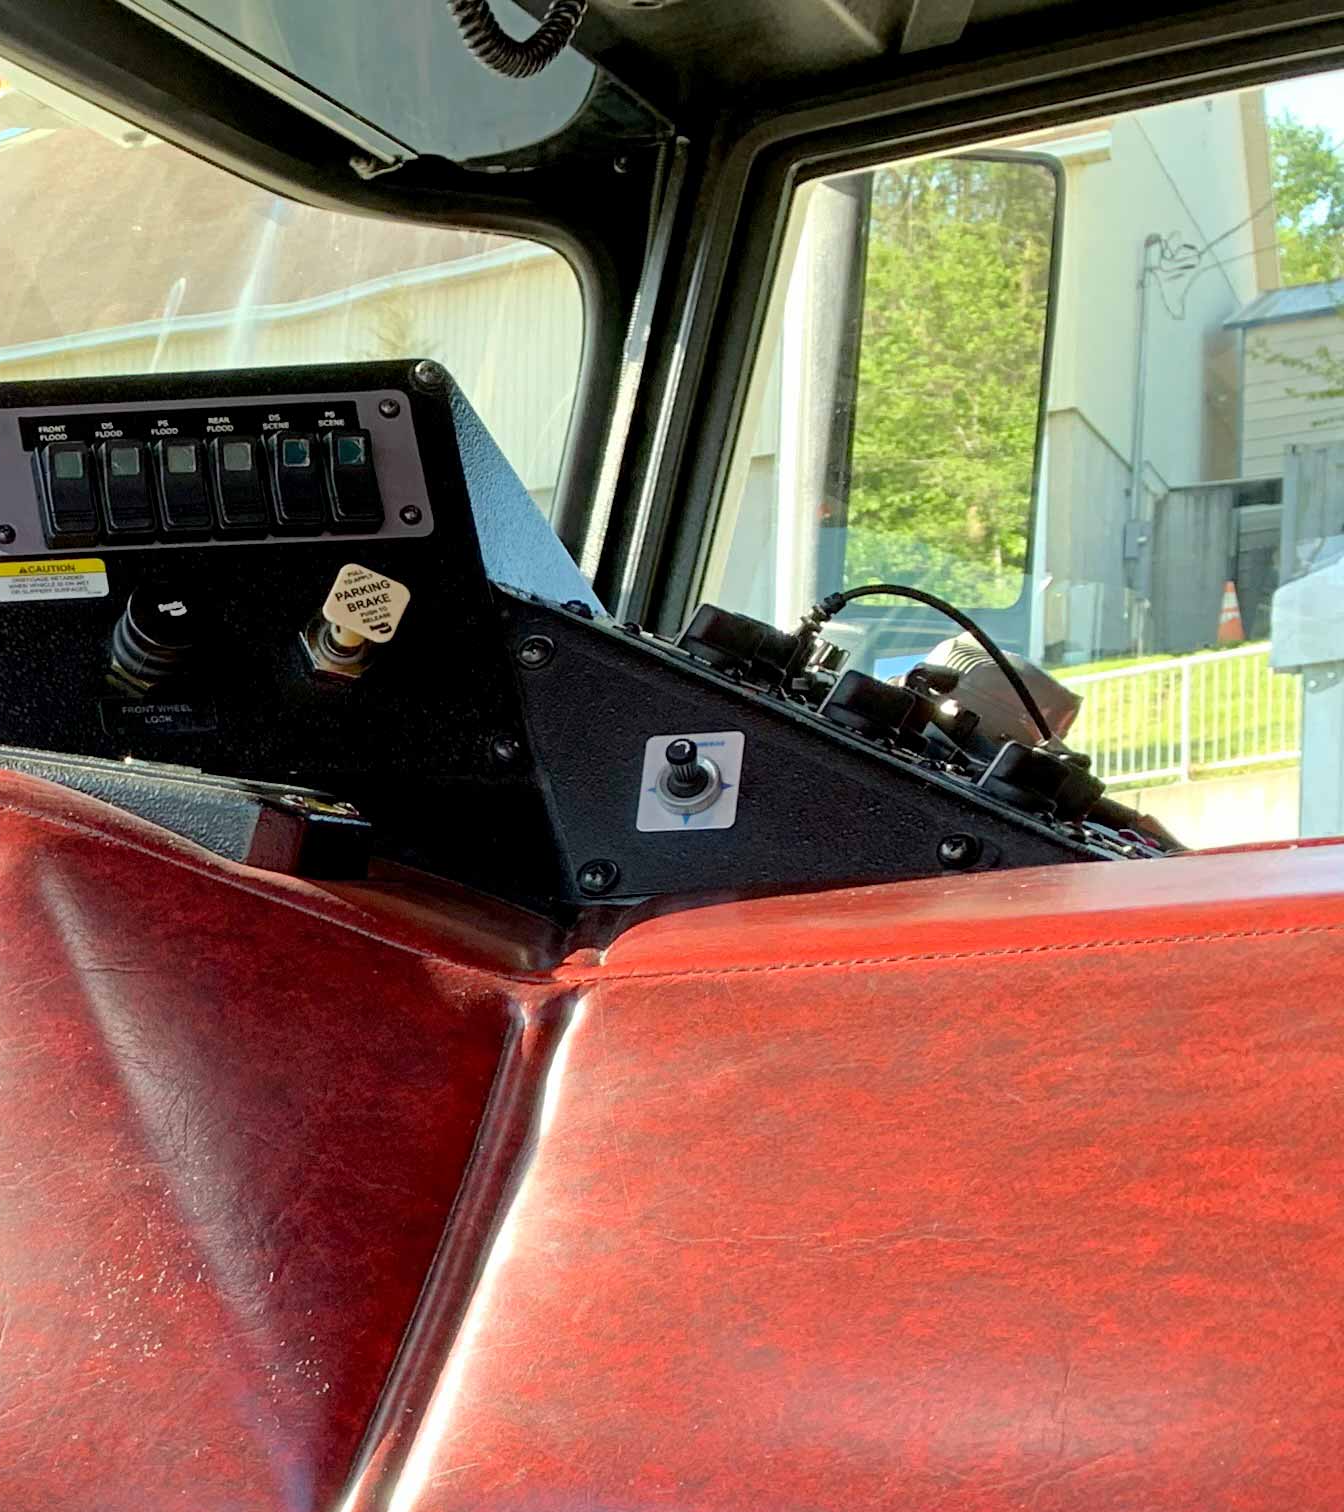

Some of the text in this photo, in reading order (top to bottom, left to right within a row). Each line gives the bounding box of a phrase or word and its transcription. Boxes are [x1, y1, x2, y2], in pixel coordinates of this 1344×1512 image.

[38, 425, 66, 433] FRONT
[27, 564, 75, 574] CAUTION
[335, 579, 391, 602] PARKING
[347, 593, 391, 613] BRAKE
[122, 704, 192, 713] FRONT WHEEL
[144, 715, 173, 724] LOCK
